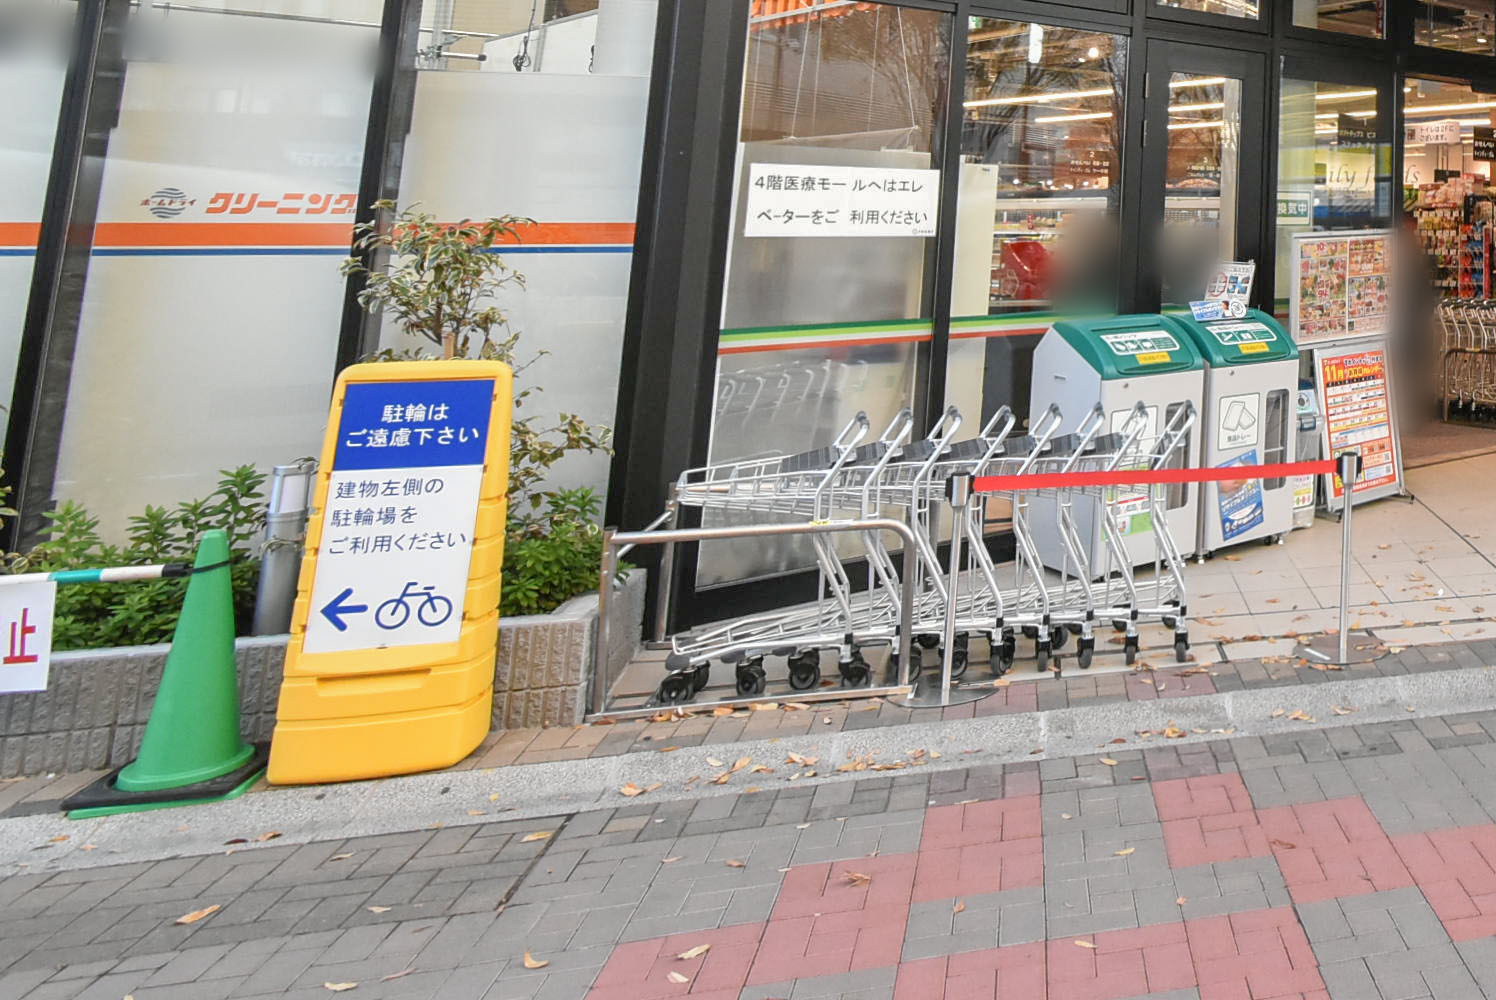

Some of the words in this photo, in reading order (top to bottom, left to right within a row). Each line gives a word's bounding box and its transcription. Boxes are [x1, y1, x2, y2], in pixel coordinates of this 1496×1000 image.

[205, 192, 359, 215] クリーニング
[381, 402, 449, 424] 駐輪は
[345, 426, 480, 448] ご遠慮下さい
[337, 477, 444, 500] 建物左側の
[330, 505, 418, 528] 駐輪場を
[328, 531, 468, 555] ご利用ください
